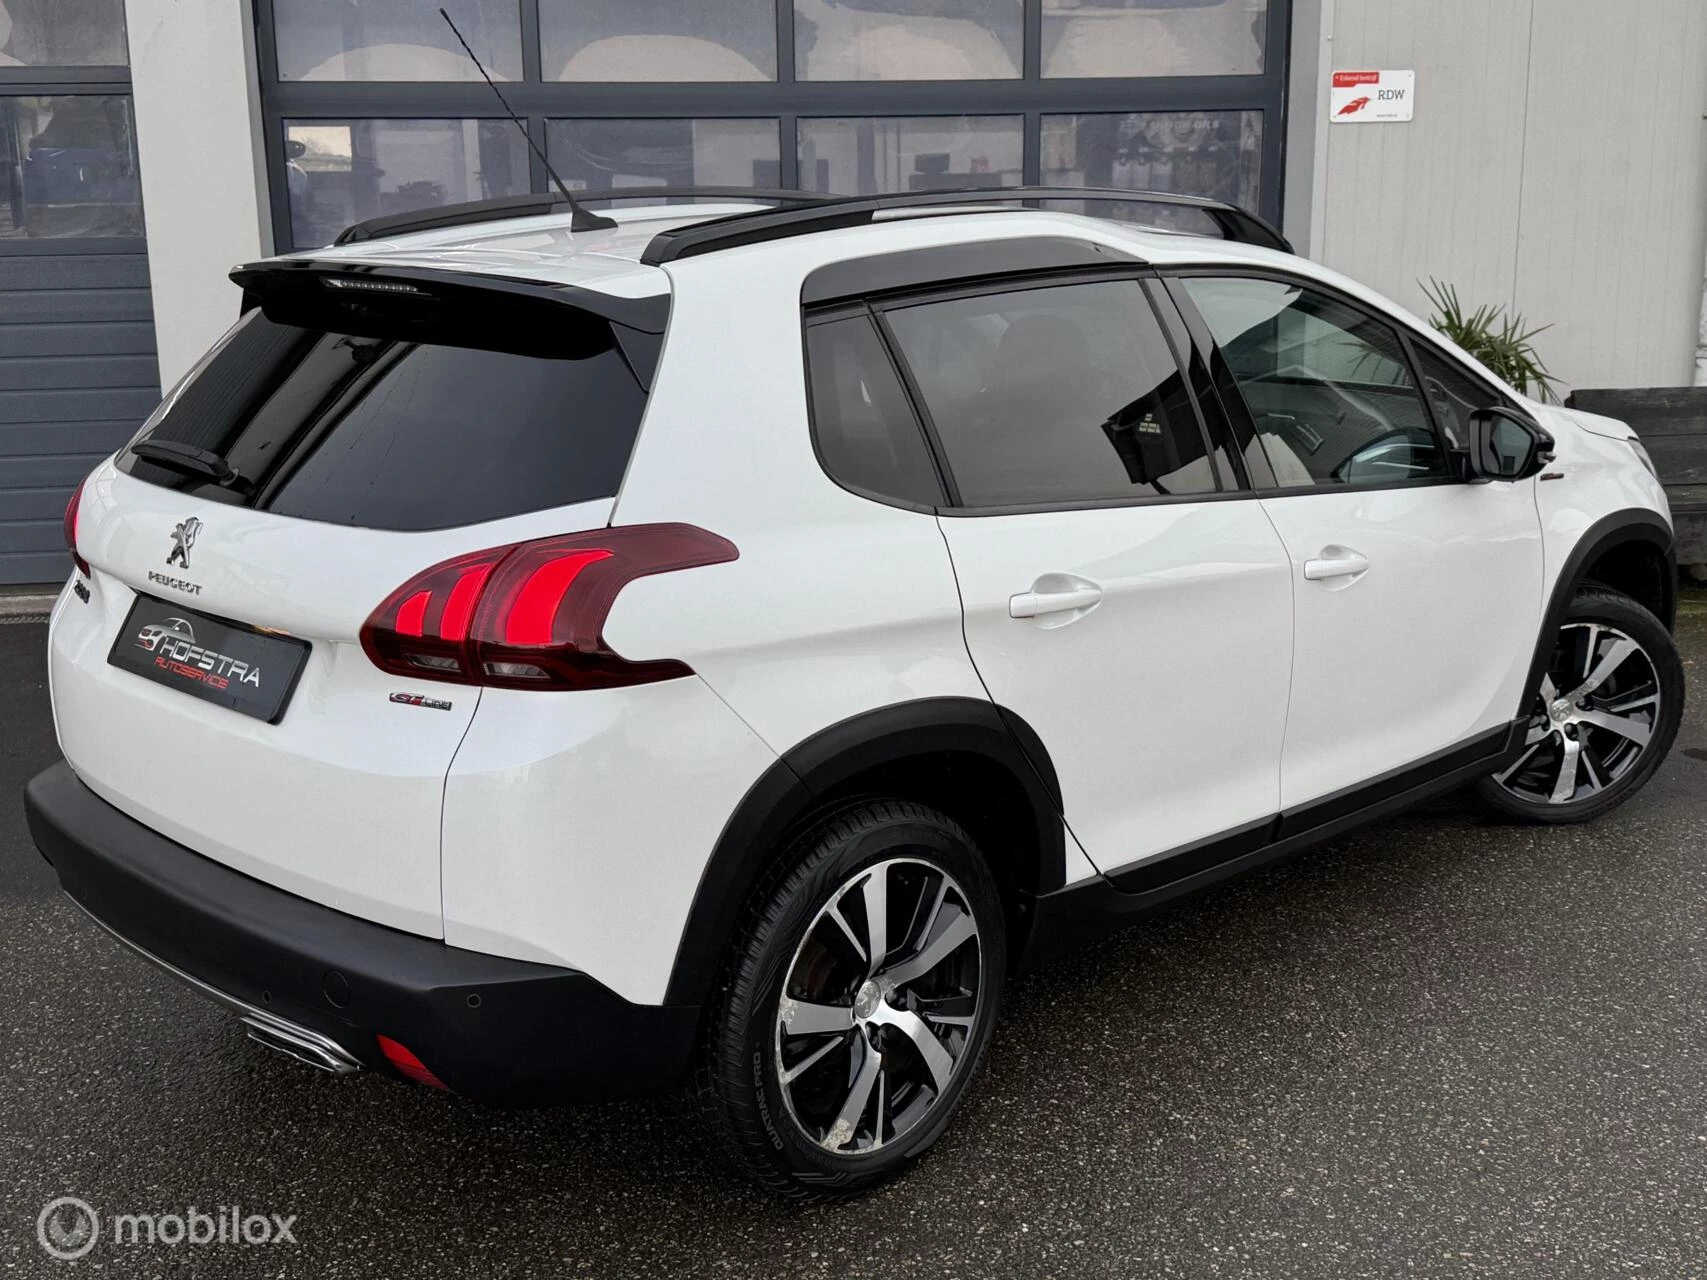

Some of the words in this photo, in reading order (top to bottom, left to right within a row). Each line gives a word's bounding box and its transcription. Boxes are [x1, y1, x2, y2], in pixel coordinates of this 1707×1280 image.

[1378, 89, 1405, 100] RDW
[148, 570, 203, 595] PEUGEOT
[153, 656, 230, 689] AUTOSERVICE
[159, 635, 261, 688] HOFSTRA
[753, 1052, 763, 1087] PRO
[757, 1088, 784, 1151] QUATRAC
